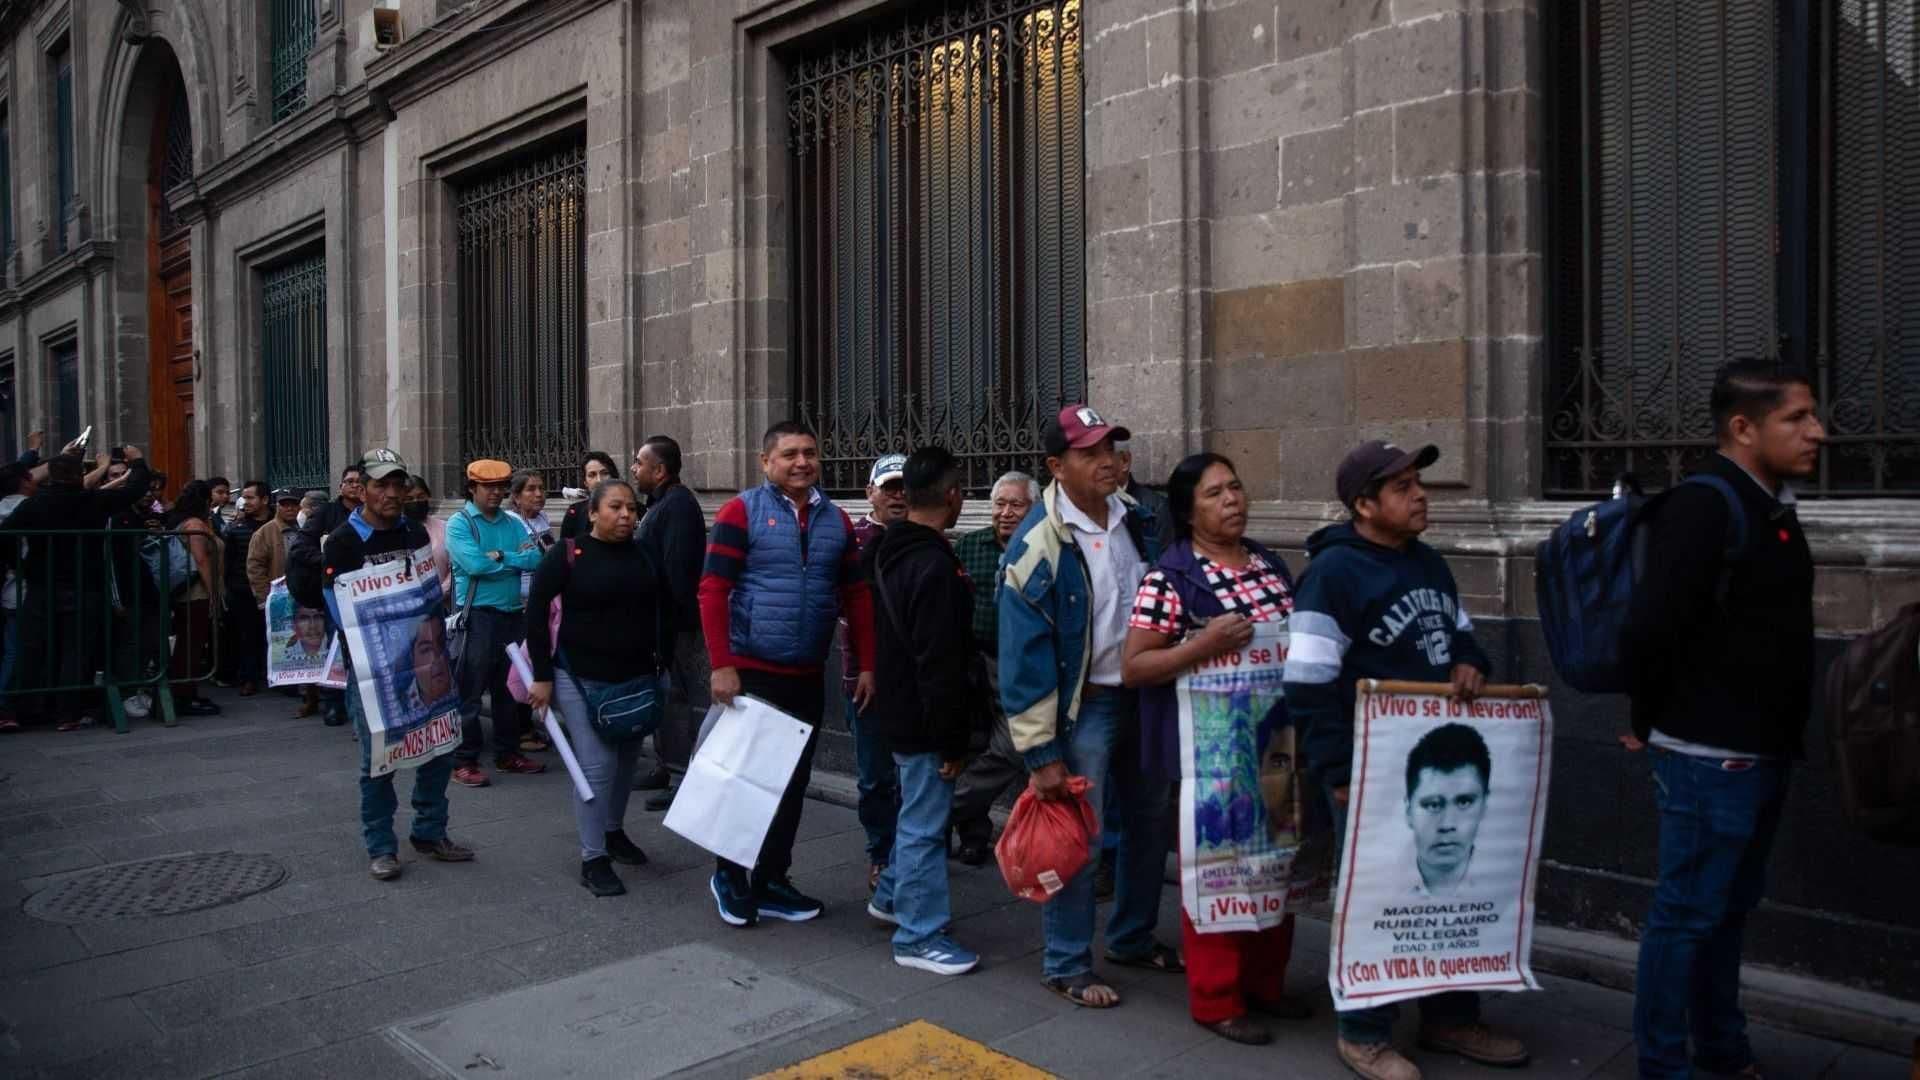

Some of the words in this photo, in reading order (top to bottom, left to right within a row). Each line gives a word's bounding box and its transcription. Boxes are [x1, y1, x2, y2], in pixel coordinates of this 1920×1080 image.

[1248, 648, 1271, 664] se
[1371, 697, 1417, 719] ¡Vivo
[1423, 700, 1441, 716] se
[1210, 896, 1257, 921] ¡Vivo
[1263, 895, 1280, 912] lo
[1383, 901, 1495, 916] MAGDALENO
[1442, 913, 1500, 928] LAURO
[1392, 926, 1480, 942] VILLEGAS
[1346, 960, 1379, 986] ¡Con
[1383, 958, 1421, 980] VIDA
[1423, 957, 1437, 979] lo
[1439, 953, 1512, 980] queremos!
